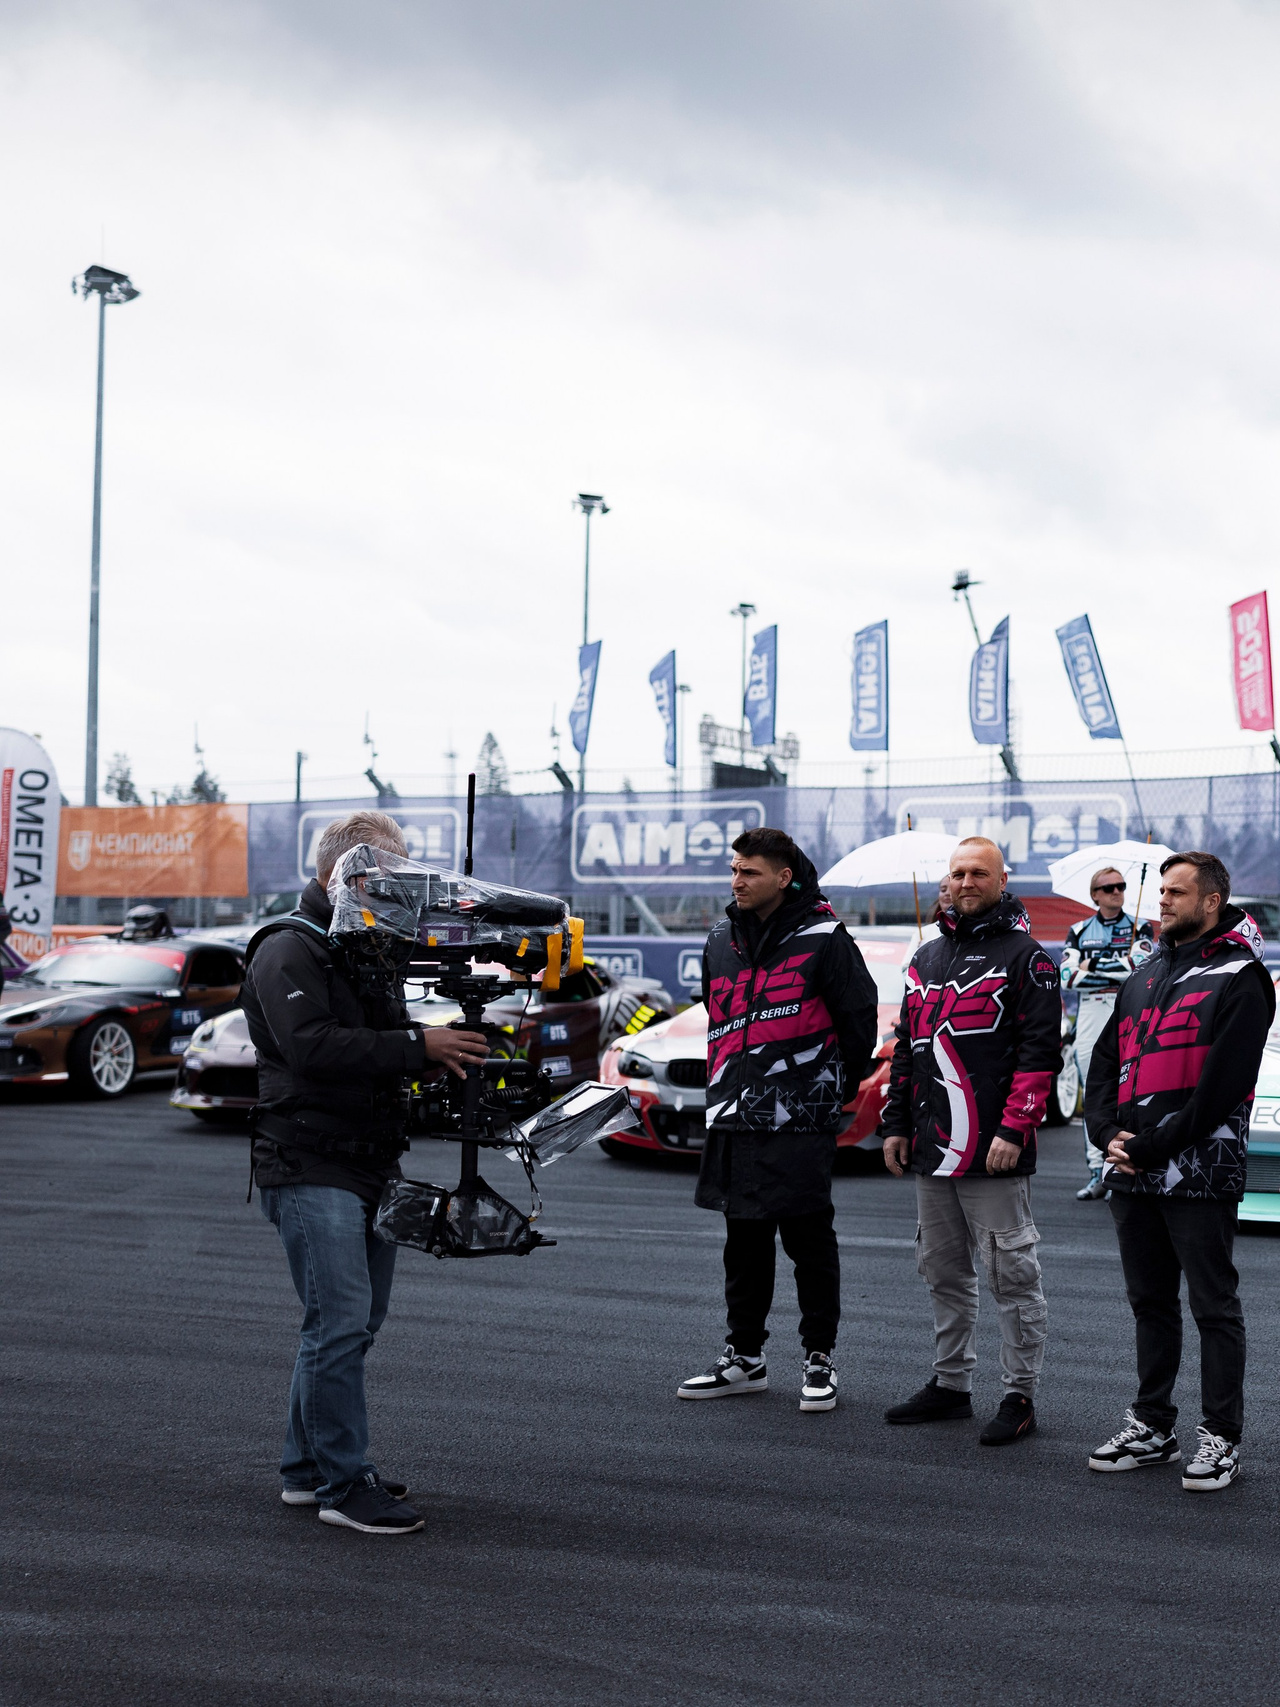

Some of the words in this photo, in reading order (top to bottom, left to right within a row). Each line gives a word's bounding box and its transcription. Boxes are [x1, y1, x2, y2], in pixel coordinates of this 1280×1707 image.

[707, 1022, 732, 1042] USSIAN
[733, 1012, 758, 1030] DRT
[760, 1003, 800, 1020] SERIES
